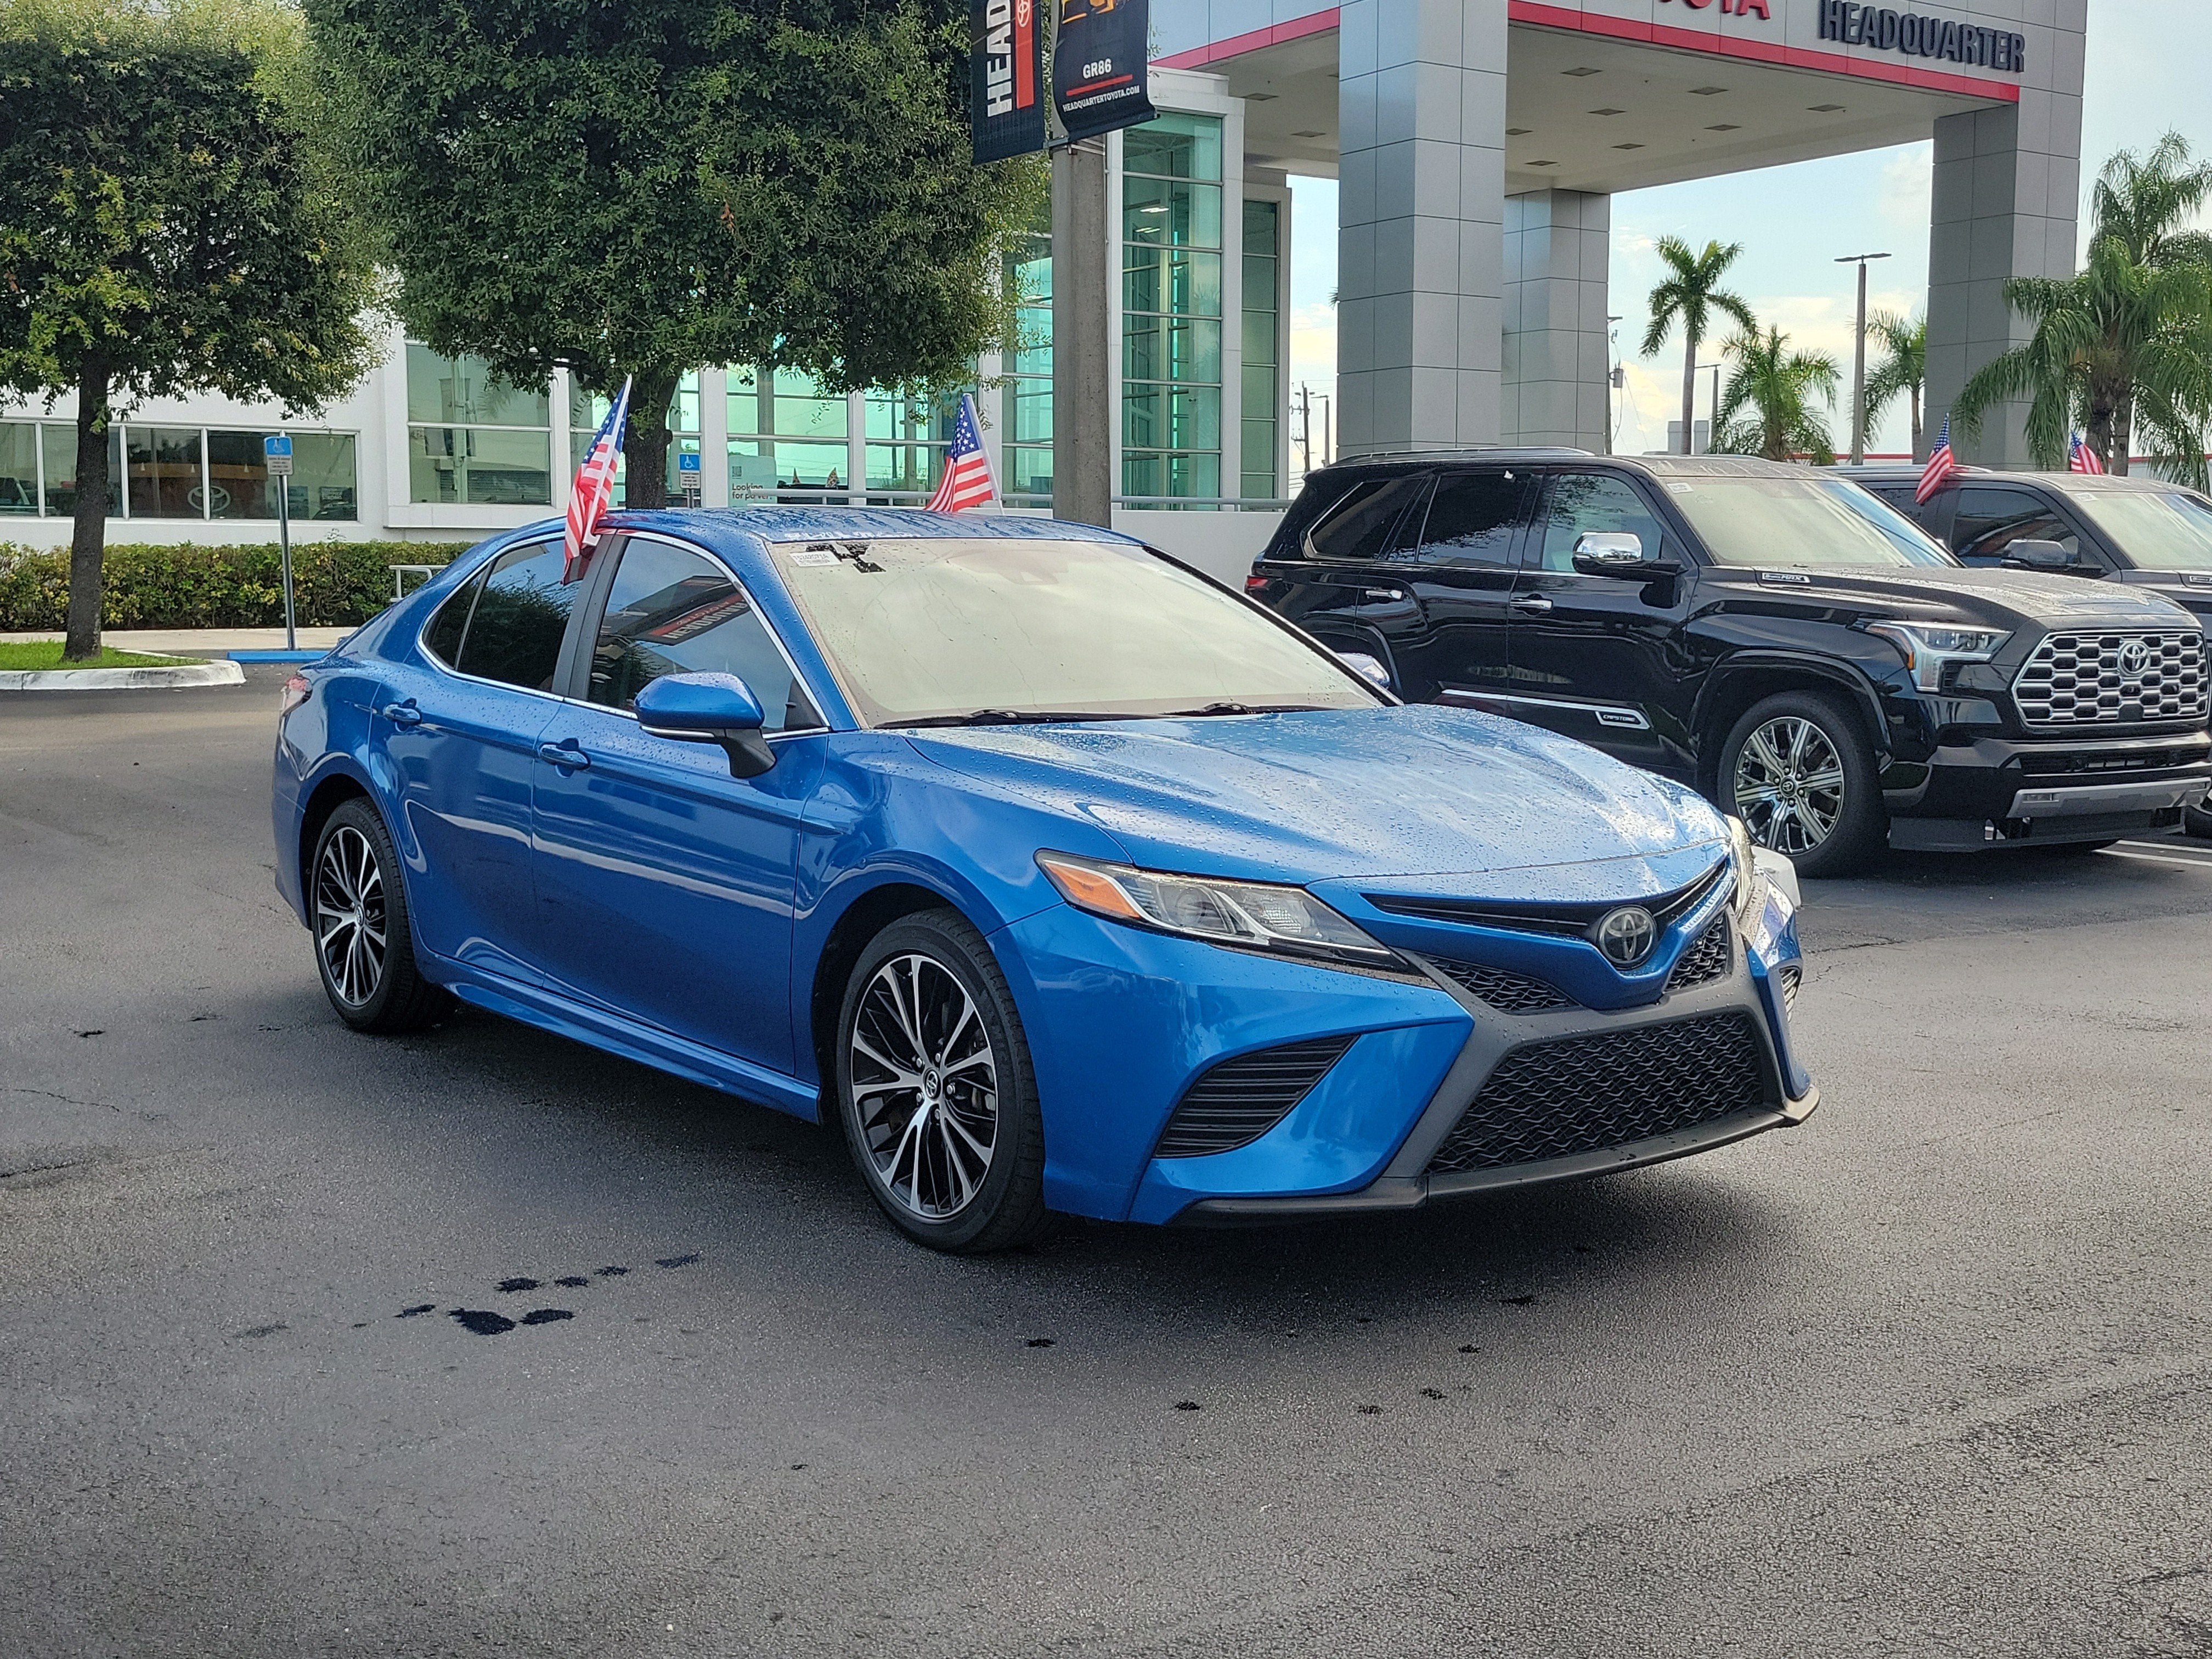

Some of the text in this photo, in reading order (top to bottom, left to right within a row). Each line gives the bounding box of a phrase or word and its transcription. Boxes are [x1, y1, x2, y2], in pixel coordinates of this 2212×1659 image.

[986, 0, 1012, 117] HEAD
[1818, 0, 2025, 72] HEADQUARTER
[1083, 58, 1112, 79] GR86
[1063, 85, 1140, 112] HEADQUARTERTOYOTA.COM
